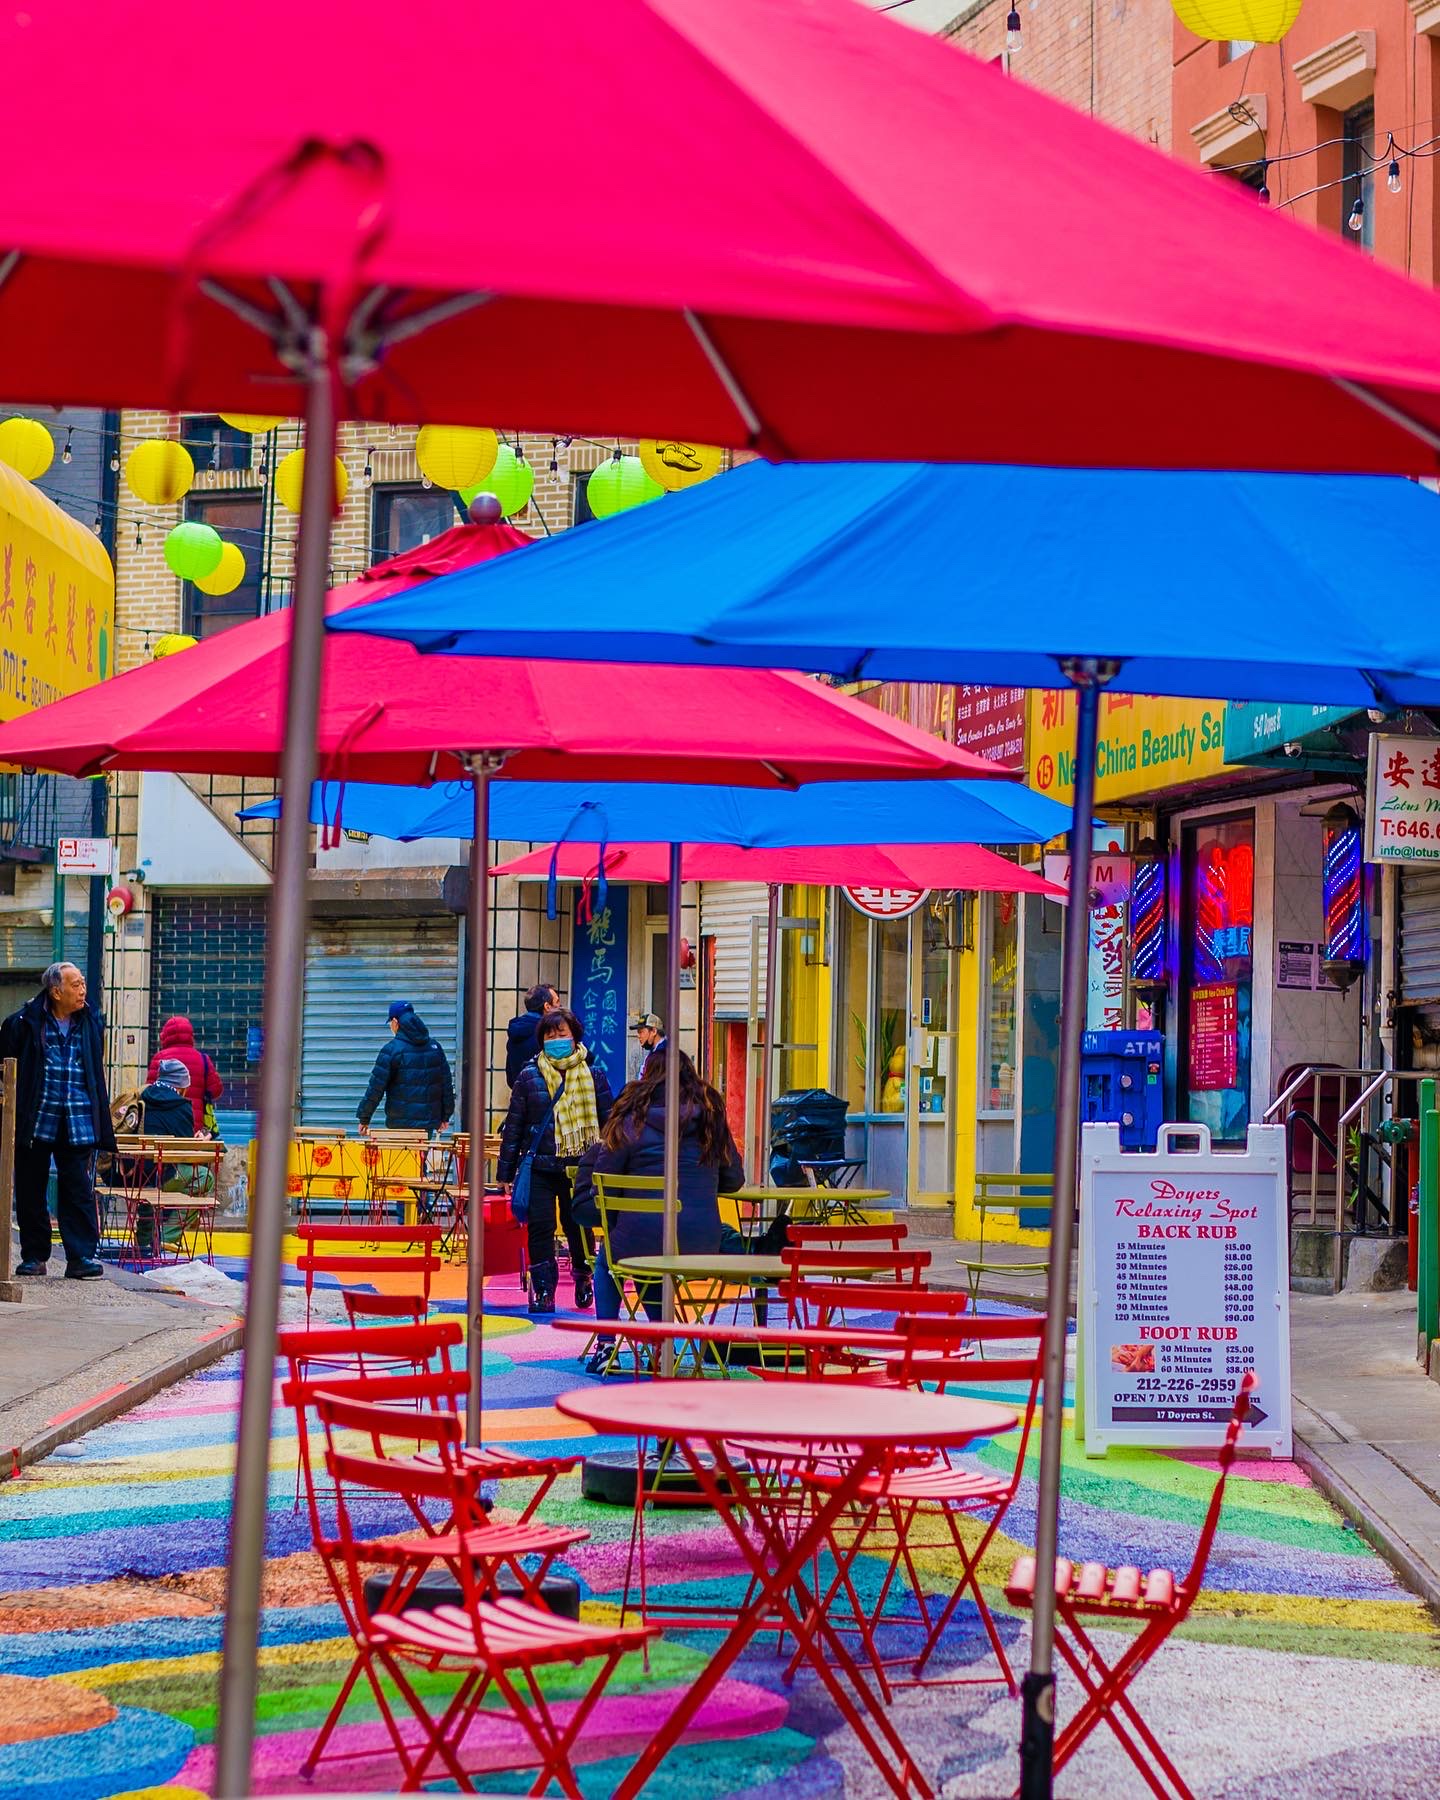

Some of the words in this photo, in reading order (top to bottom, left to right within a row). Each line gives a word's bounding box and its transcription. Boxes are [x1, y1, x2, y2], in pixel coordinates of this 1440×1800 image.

[1058, 751, 1077, 787] Ne
[1095, 737, 1137, 778] China
[1141, 723, 1196, 767] Beauty
[1380, 796, 1420, 813] Lotus
[1424, 797, 1440, 813] M
[1063, 865, 1113, 882] AM
[1005, 941, 1017, 973] Wa
[1084, 1034, 1098, 1050] ATM
[1124, 1042, 1160, 1054] ATM
[1150, 1180, 1221, 1204] Doyers
[1114, 1199, 1203, 1222] Relaxing
[1209, 1199, 1258, 1222] Spot
[1137, 1224, 1192, 1239] BACK
[1196, 1225, 1238, 1239] RUB
[1224, 1294, 1254, 1302] $60.00
[1224, 1304, 1254, 1312] $70.00
[1224, 1314, 1255, 1322] $90.00
[1139, 1326, 1192, 1340] FOOT
[1197, 1327, 1238, 1340] RUB
[1160, 1345, 1172, 1353] 30
[1174, 1345, 1212, 1353] Minutes
[1225, 1346, 1254, 1354] $25.00
[1161, 1355, 1171, 1363] 45
[1174, 1355, 1212, 1363] Minutes
[1225, 1356, 1255, 1364] $32.00
[1225, 1366, 1255, 1374] $38.00
[1136, 1378, 1236, 1391] 212-226-2959
[1113, 1393, 1146, 1403] OPEN
[1149, 1394, 1155, 1403] 7
[1157, 1394, 1189, 1403] DAYS
[1198, 1394, 1261, 1403] 10am-1m
[1157, 1411, 1165, 1419] 17
[1167, 1411, 1200, 1421] Doyers
[1202, 1411, 1216, 1419] St.
